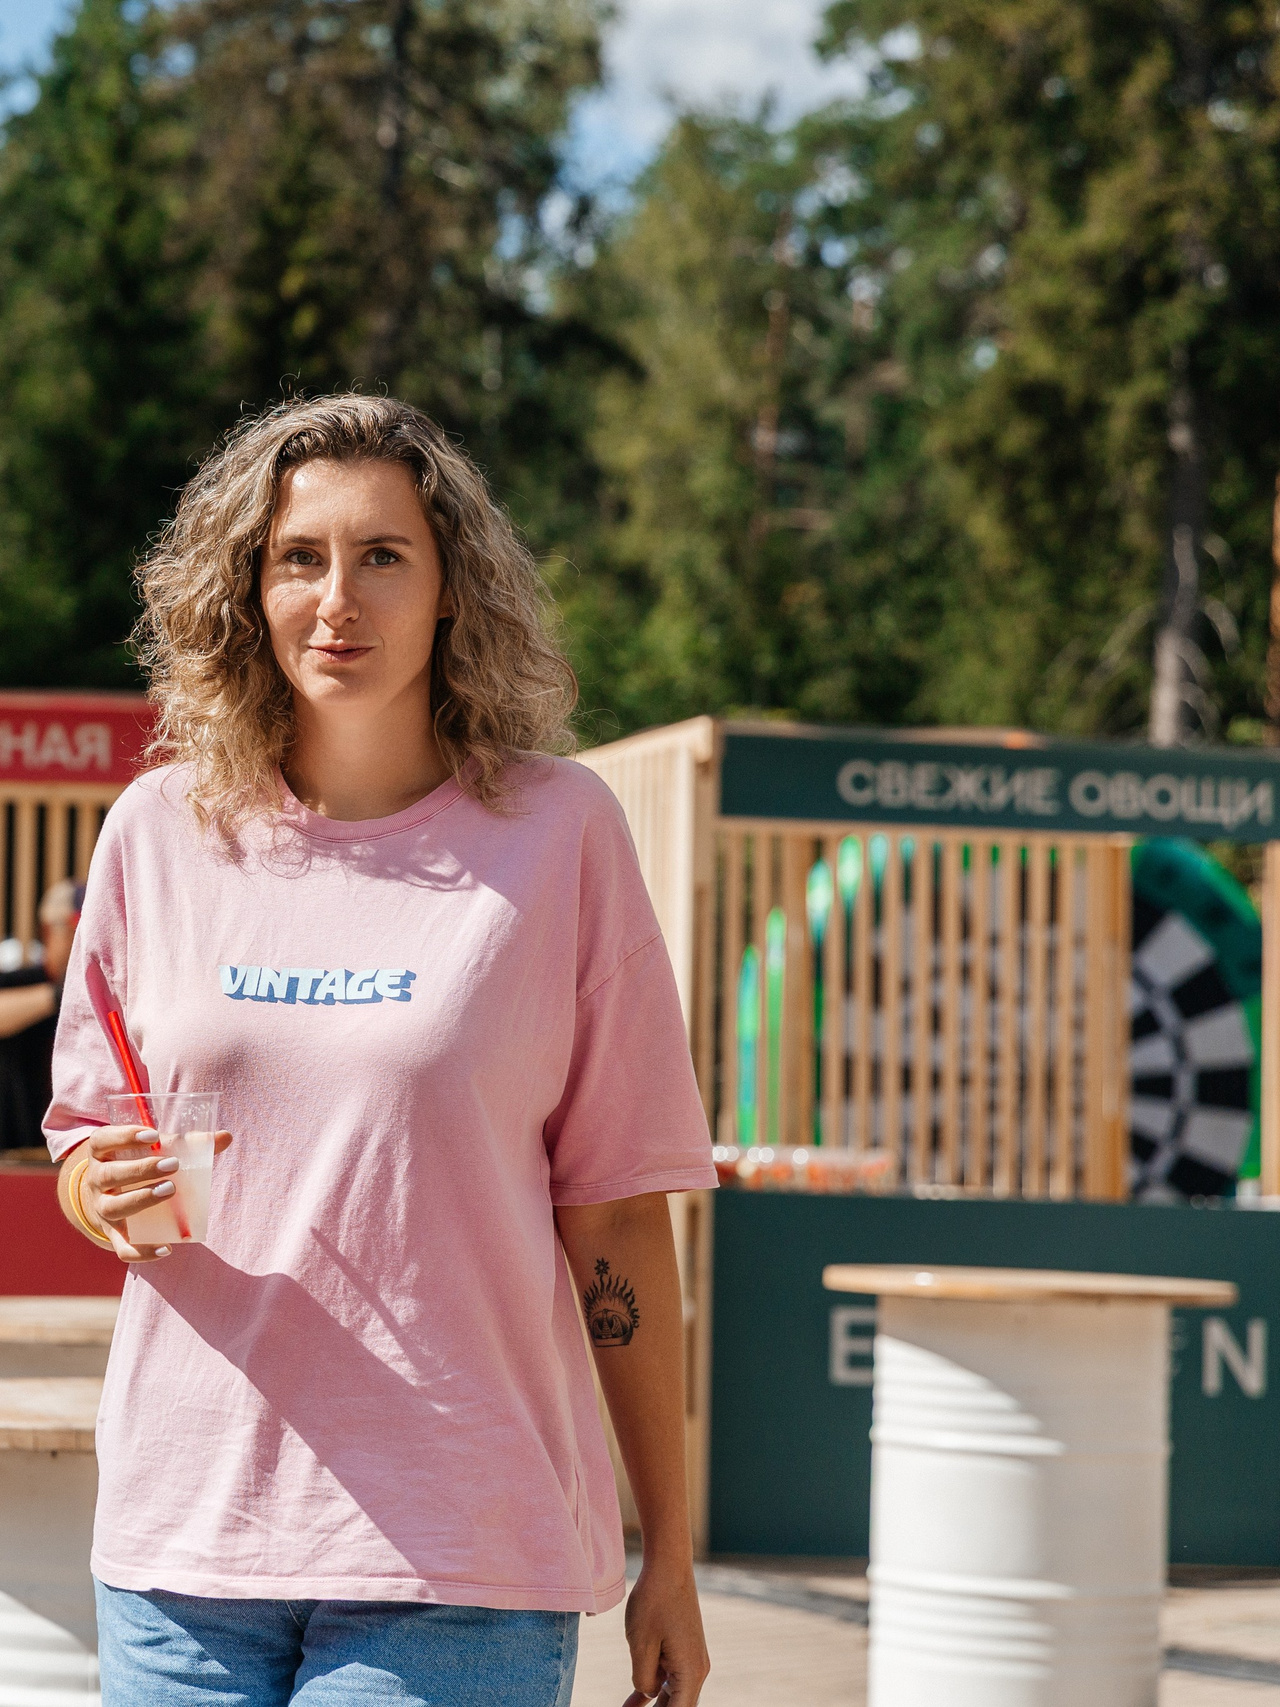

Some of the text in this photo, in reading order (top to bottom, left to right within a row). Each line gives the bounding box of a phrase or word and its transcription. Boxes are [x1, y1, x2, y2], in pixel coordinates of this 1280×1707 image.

[836, 759, 1274, 831] СВЕЖИЕ ОВОЩИ
[218, 964, 417, 1006] VINTAGE
